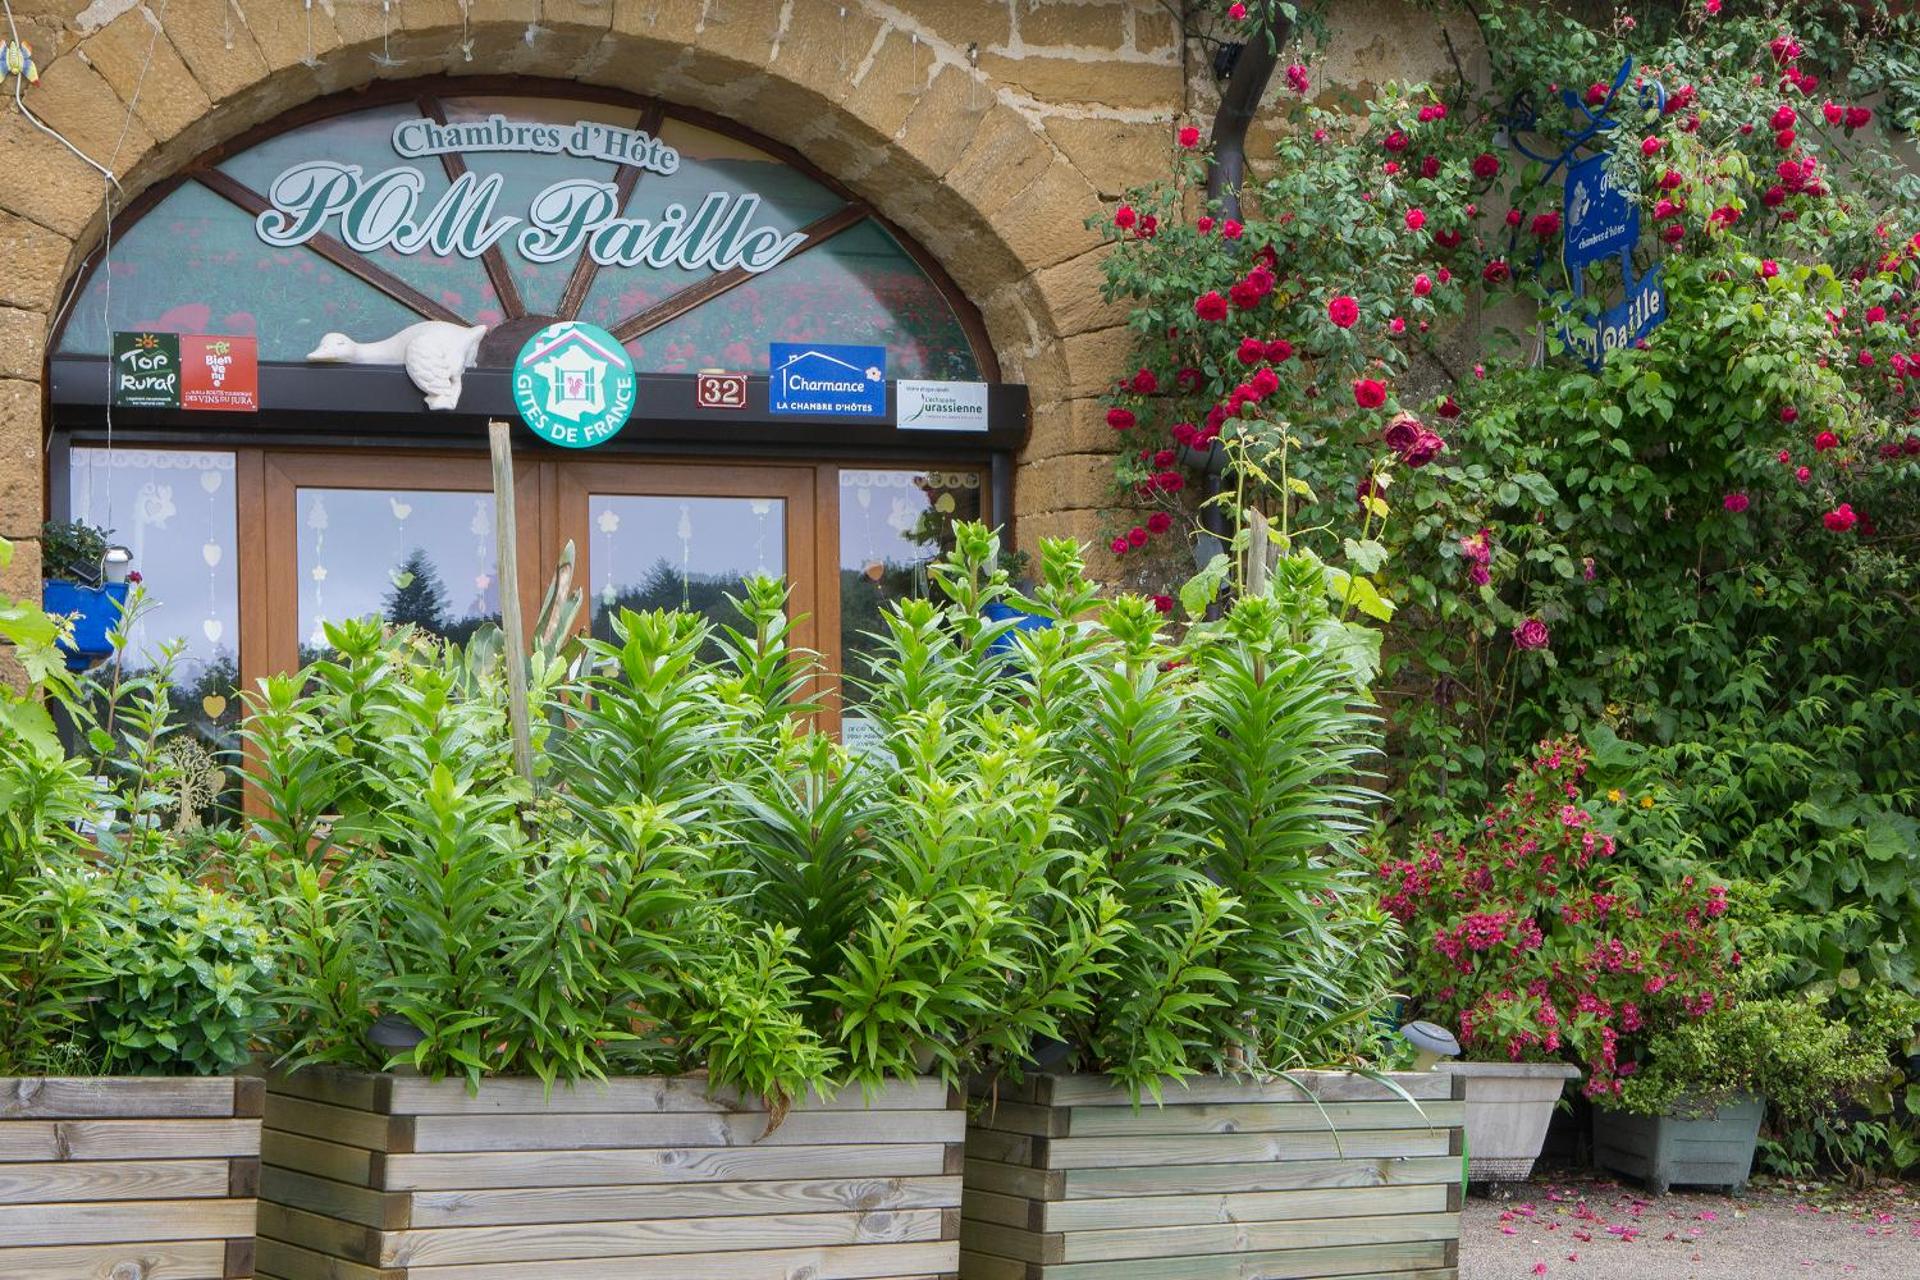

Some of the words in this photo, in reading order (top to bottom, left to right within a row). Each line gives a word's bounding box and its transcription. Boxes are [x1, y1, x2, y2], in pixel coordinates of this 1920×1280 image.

[400, 119, 560, 152] Chambres
[570, 126, 676, 170] d'Hôte
[258, 163, 520, 257] POM
[520, 181, 806, 271] Paille
[205, 355, 232, 365] Bien
[120, 373, 175, 394] Rural
[705, 379, 739, 403] 32
[789, 375, 865, 393] Charmance
[198, 396, 220, 404] VINS
[231, 397, 253, 406] JURA
[517, 374, 549, 429] GITES
[551, 424, 578, 442] DE
[583, 377, 632, 441] FRANCE
[777, 402, 788, 410] LA
[790, 402, 833, 411] CHAMBRE
[836, 402, 873, 412] D'HÔTES
